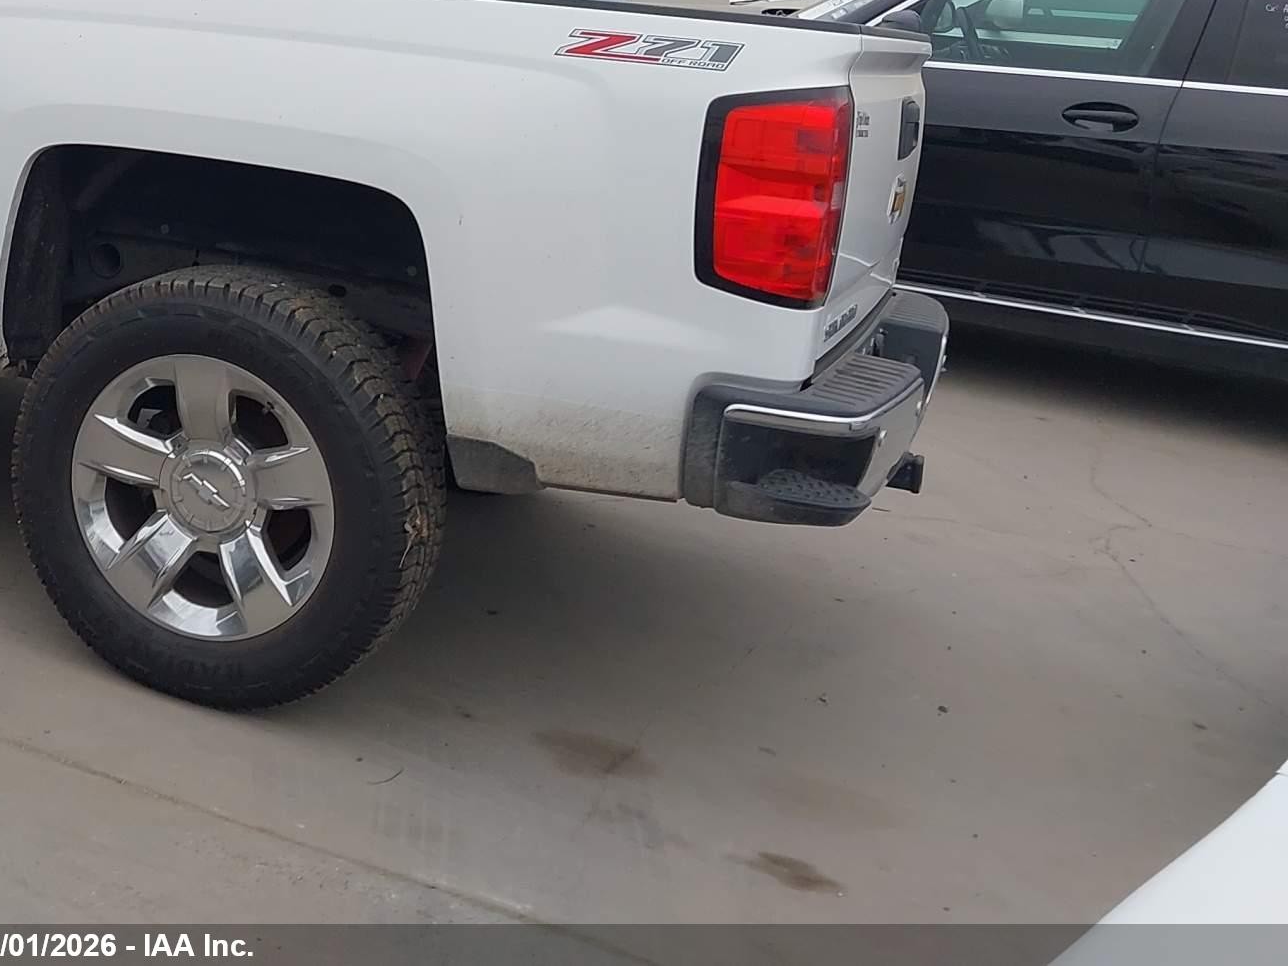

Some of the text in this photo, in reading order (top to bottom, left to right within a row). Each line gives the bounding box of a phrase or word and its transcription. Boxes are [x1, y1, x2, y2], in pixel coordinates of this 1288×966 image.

[555, 28, 745, 71] Z71
[662, 57, 725, 69] OFF ROAD
